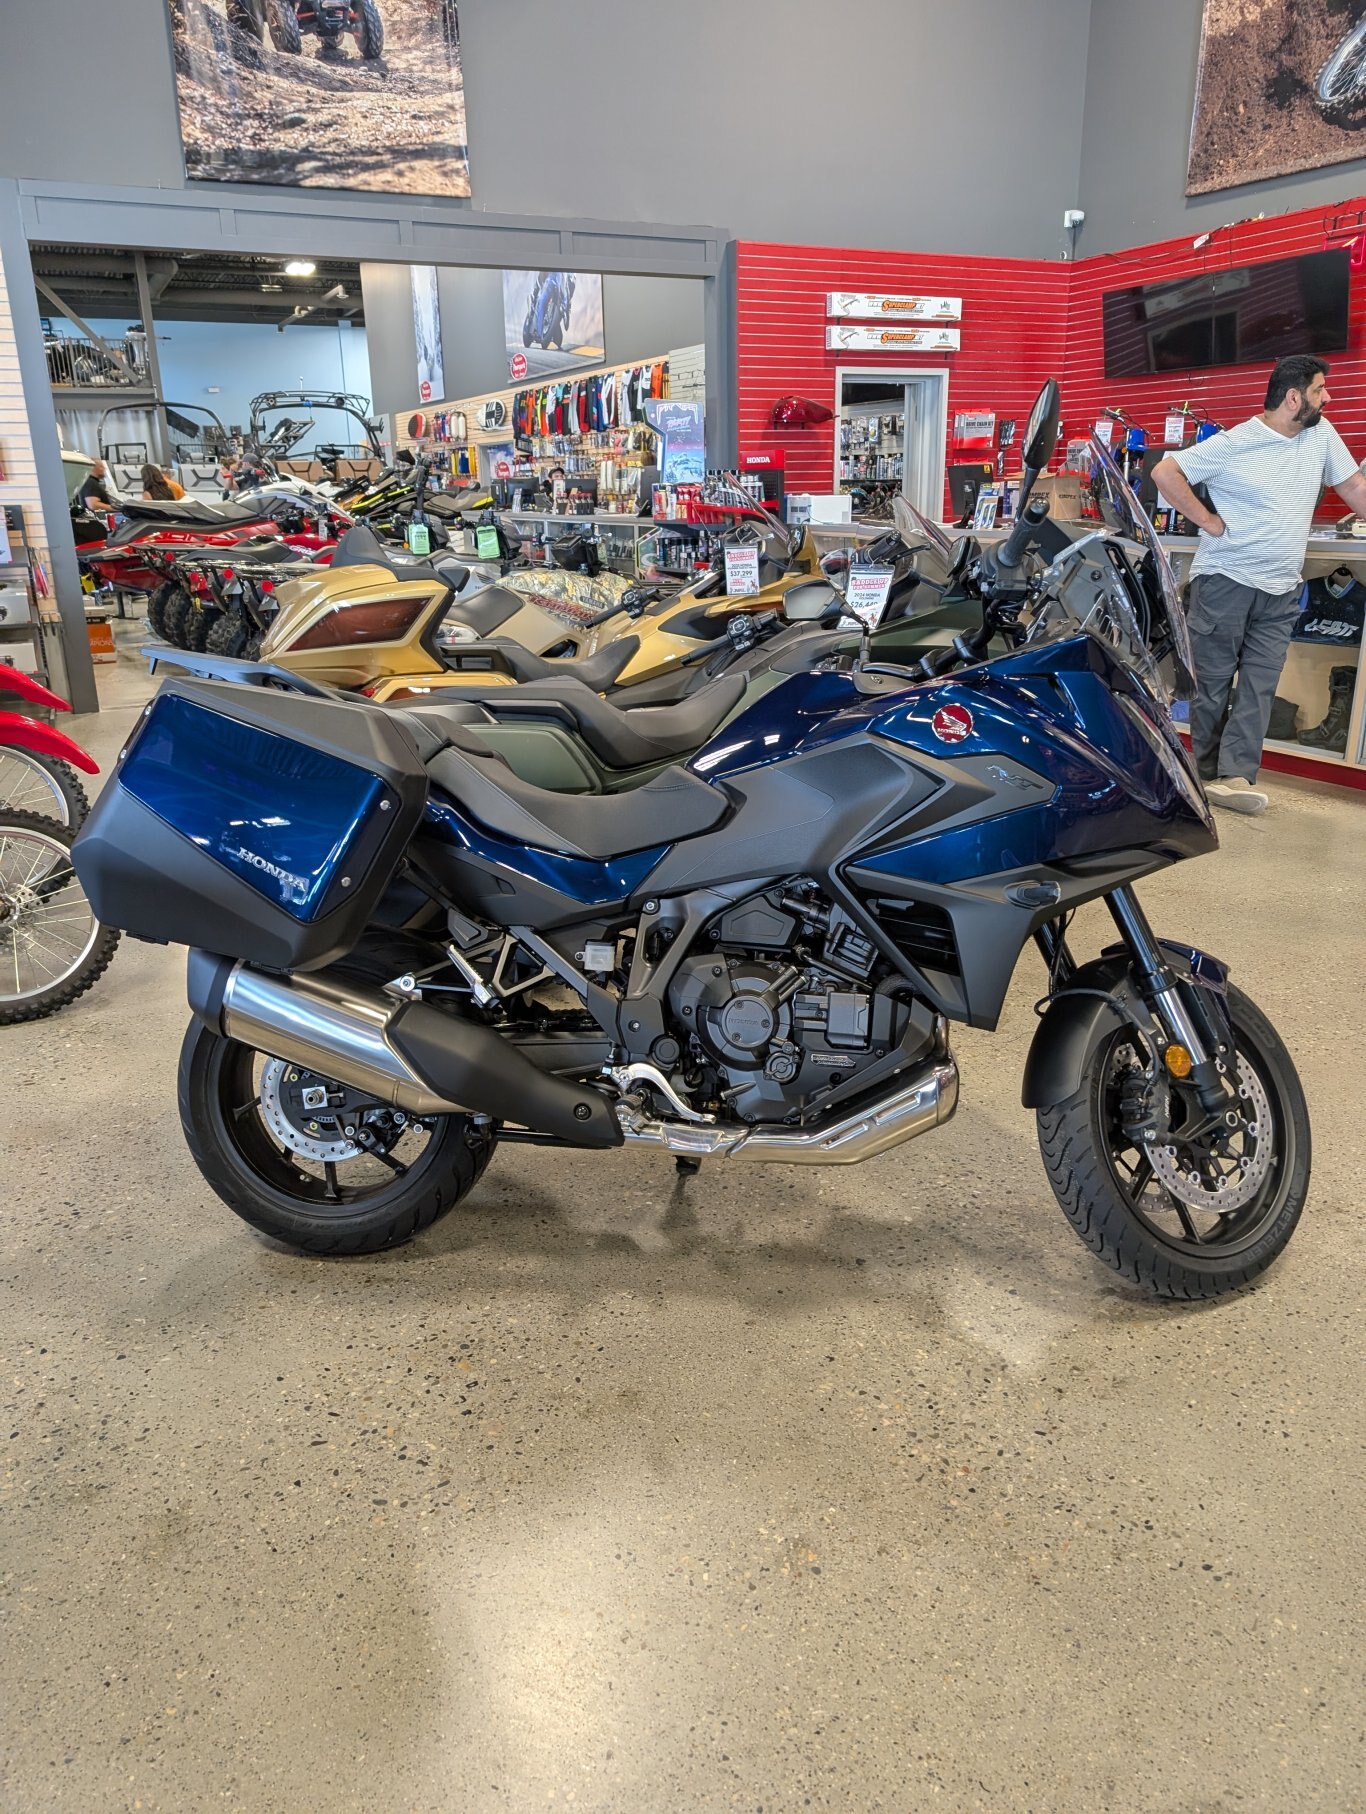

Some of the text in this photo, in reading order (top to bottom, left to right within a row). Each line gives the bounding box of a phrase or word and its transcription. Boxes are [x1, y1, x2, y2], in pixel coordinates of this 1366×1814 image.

[746, 456, 771, 464] HONDA
[236, 846, 306, 892] HONDA
[1243, 1197, 1298, 1262] METZELER
